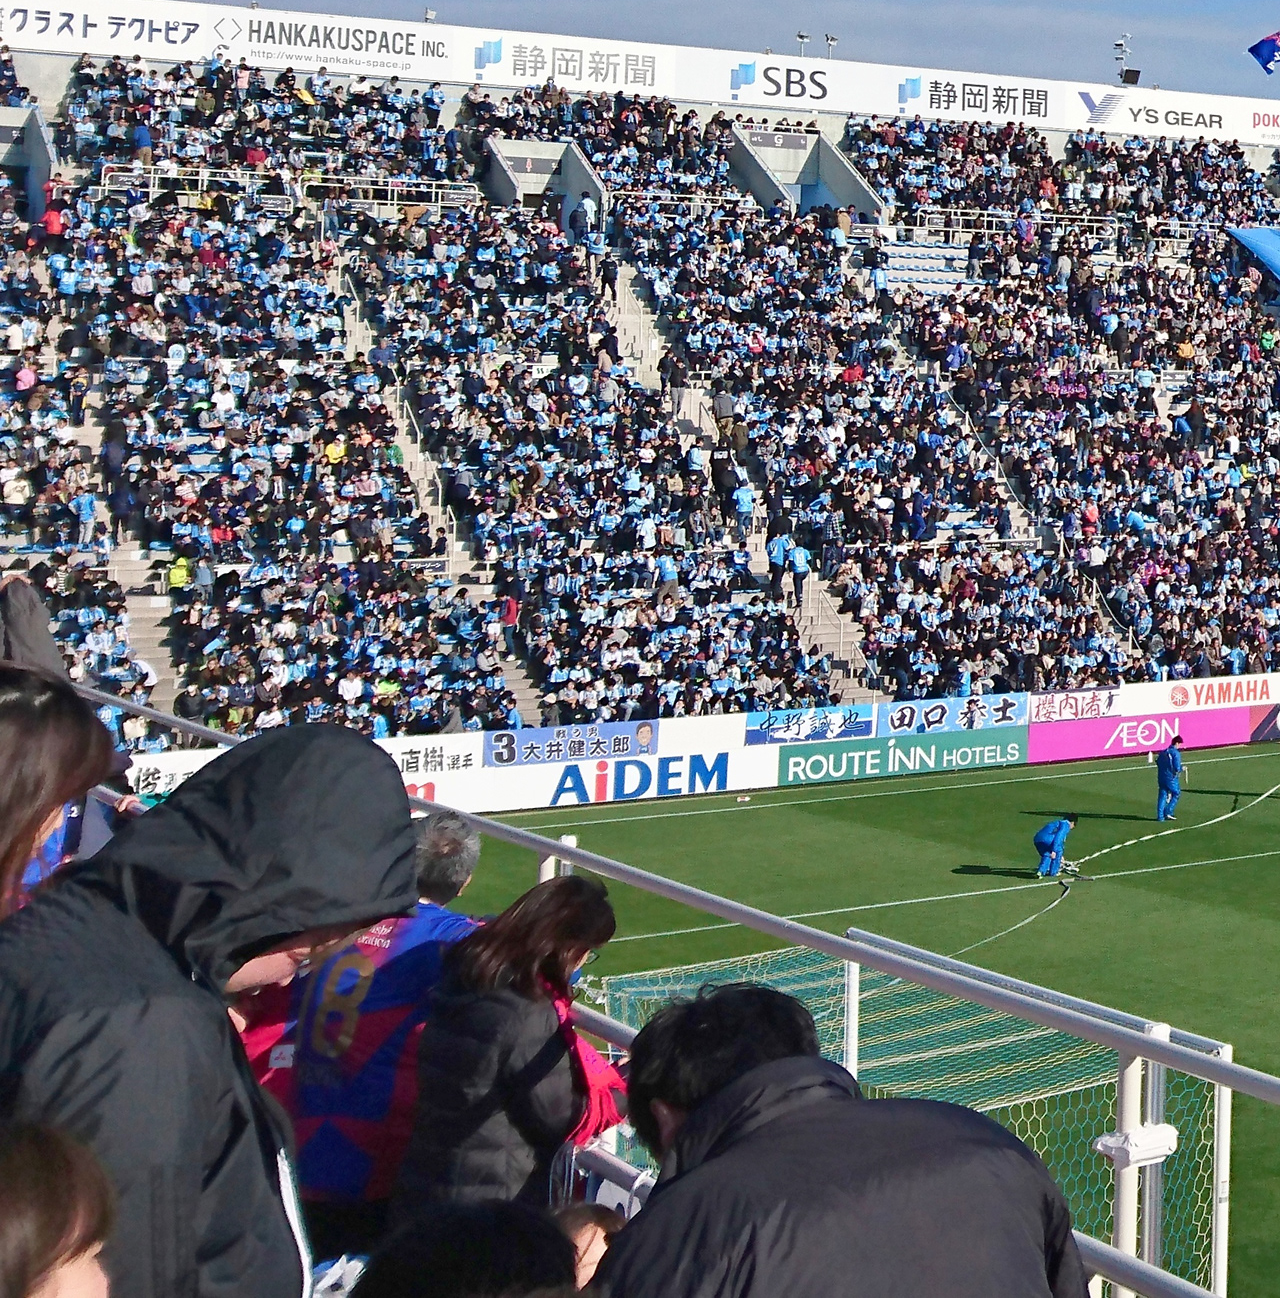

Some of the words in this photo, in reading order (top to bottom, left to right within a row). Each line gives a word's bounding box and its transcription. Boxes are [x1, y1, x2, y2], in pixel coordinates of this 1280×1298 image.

[9, 8, 98, 39] クラスト
[107, 15, 200, 44] テクトピア
[247, 19, 417, 56] HANKAKUSPACE
[421, 40, 449, 59] INC.
[250, 49, 412, 71] http://www.hankaku-space.jp
[511, 43, 657, 87] 静岡新聞
[762, 66, 828, 100] SBS
[927, 79, 1049, 118] 静岡新聞
[1127, 105, 1159, 124] Y'S
[1163, 110, 1223, 129] GEAR
[1193, 679, 1270, 706] YAMAHA
[759, 708, 865, 736] 中野誠也
[889, 698, 1017, 731] 田口泰士
[492, 732, 516, 765] 3
[521, 736, 631, 761] 大井健太郎
[555, 727, 598, 738] 戦う男
[388, 745, 474, 773] 直樹選手
[787, 751, 881, 782] ROUTE
[942, 742, 1021, 765] HOTELS
